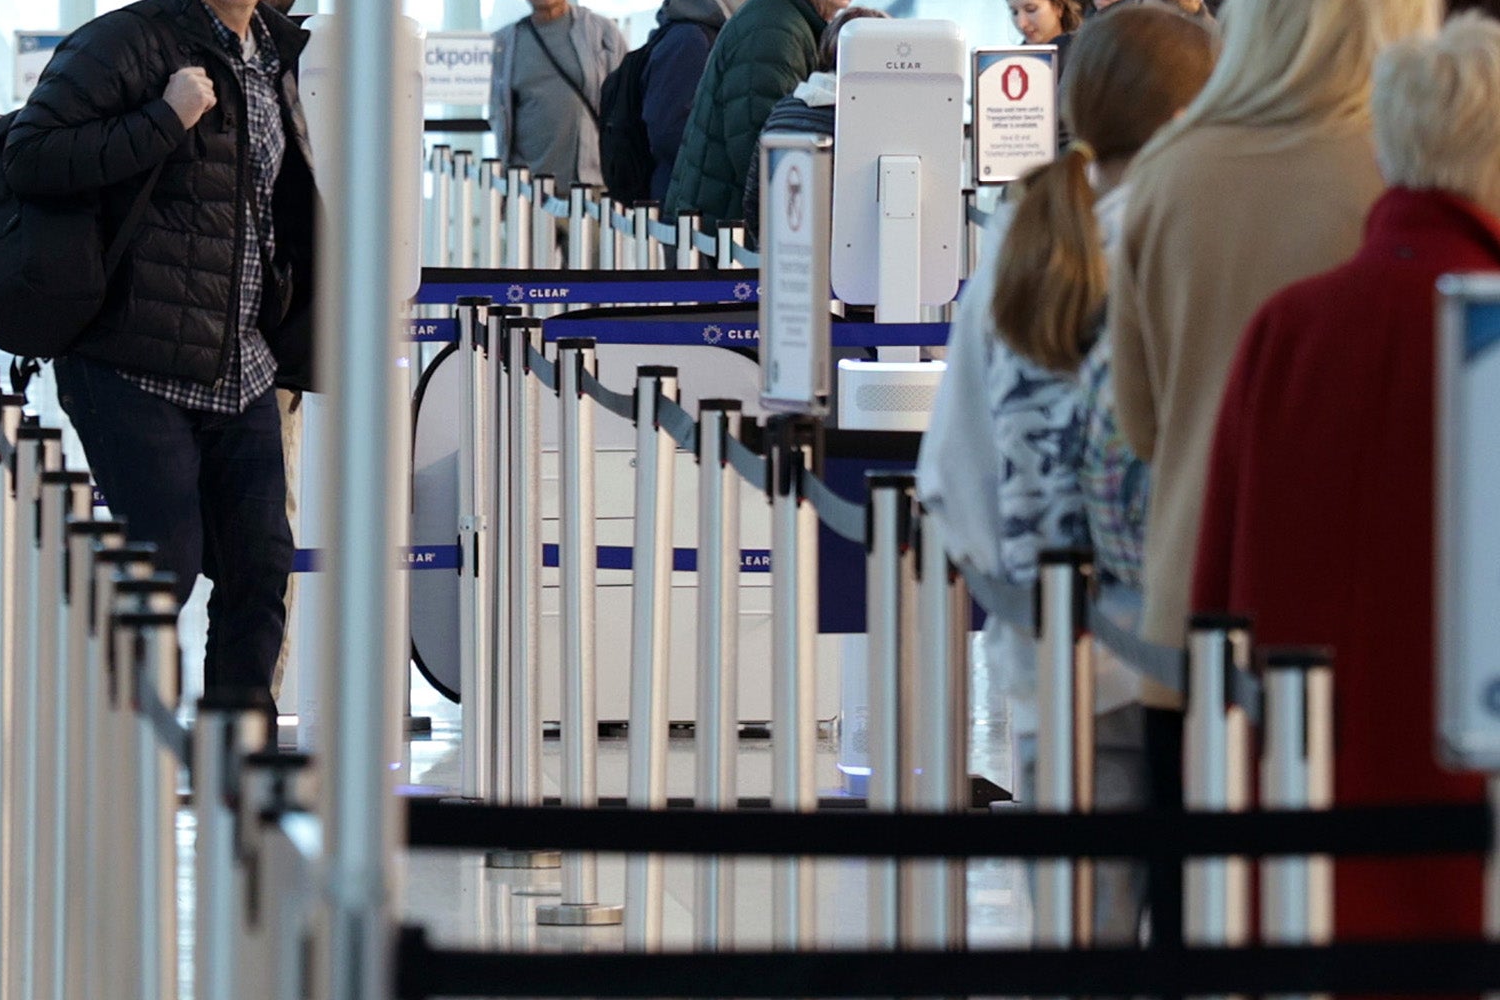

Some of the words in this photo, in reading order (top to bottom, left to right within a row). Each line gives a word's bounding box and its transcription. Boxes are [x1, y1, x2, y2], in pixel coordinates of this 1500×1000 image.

[425, 46, 491, 70] ckpoin
[885, 61, 922, 70] CLEAR
[529, 288, 567, 298] CLEAR
[403, 325, 435, 335] LEAR
[728, 330, 761, 339] CLEA
[401, 552, 432, 563] LEAR
